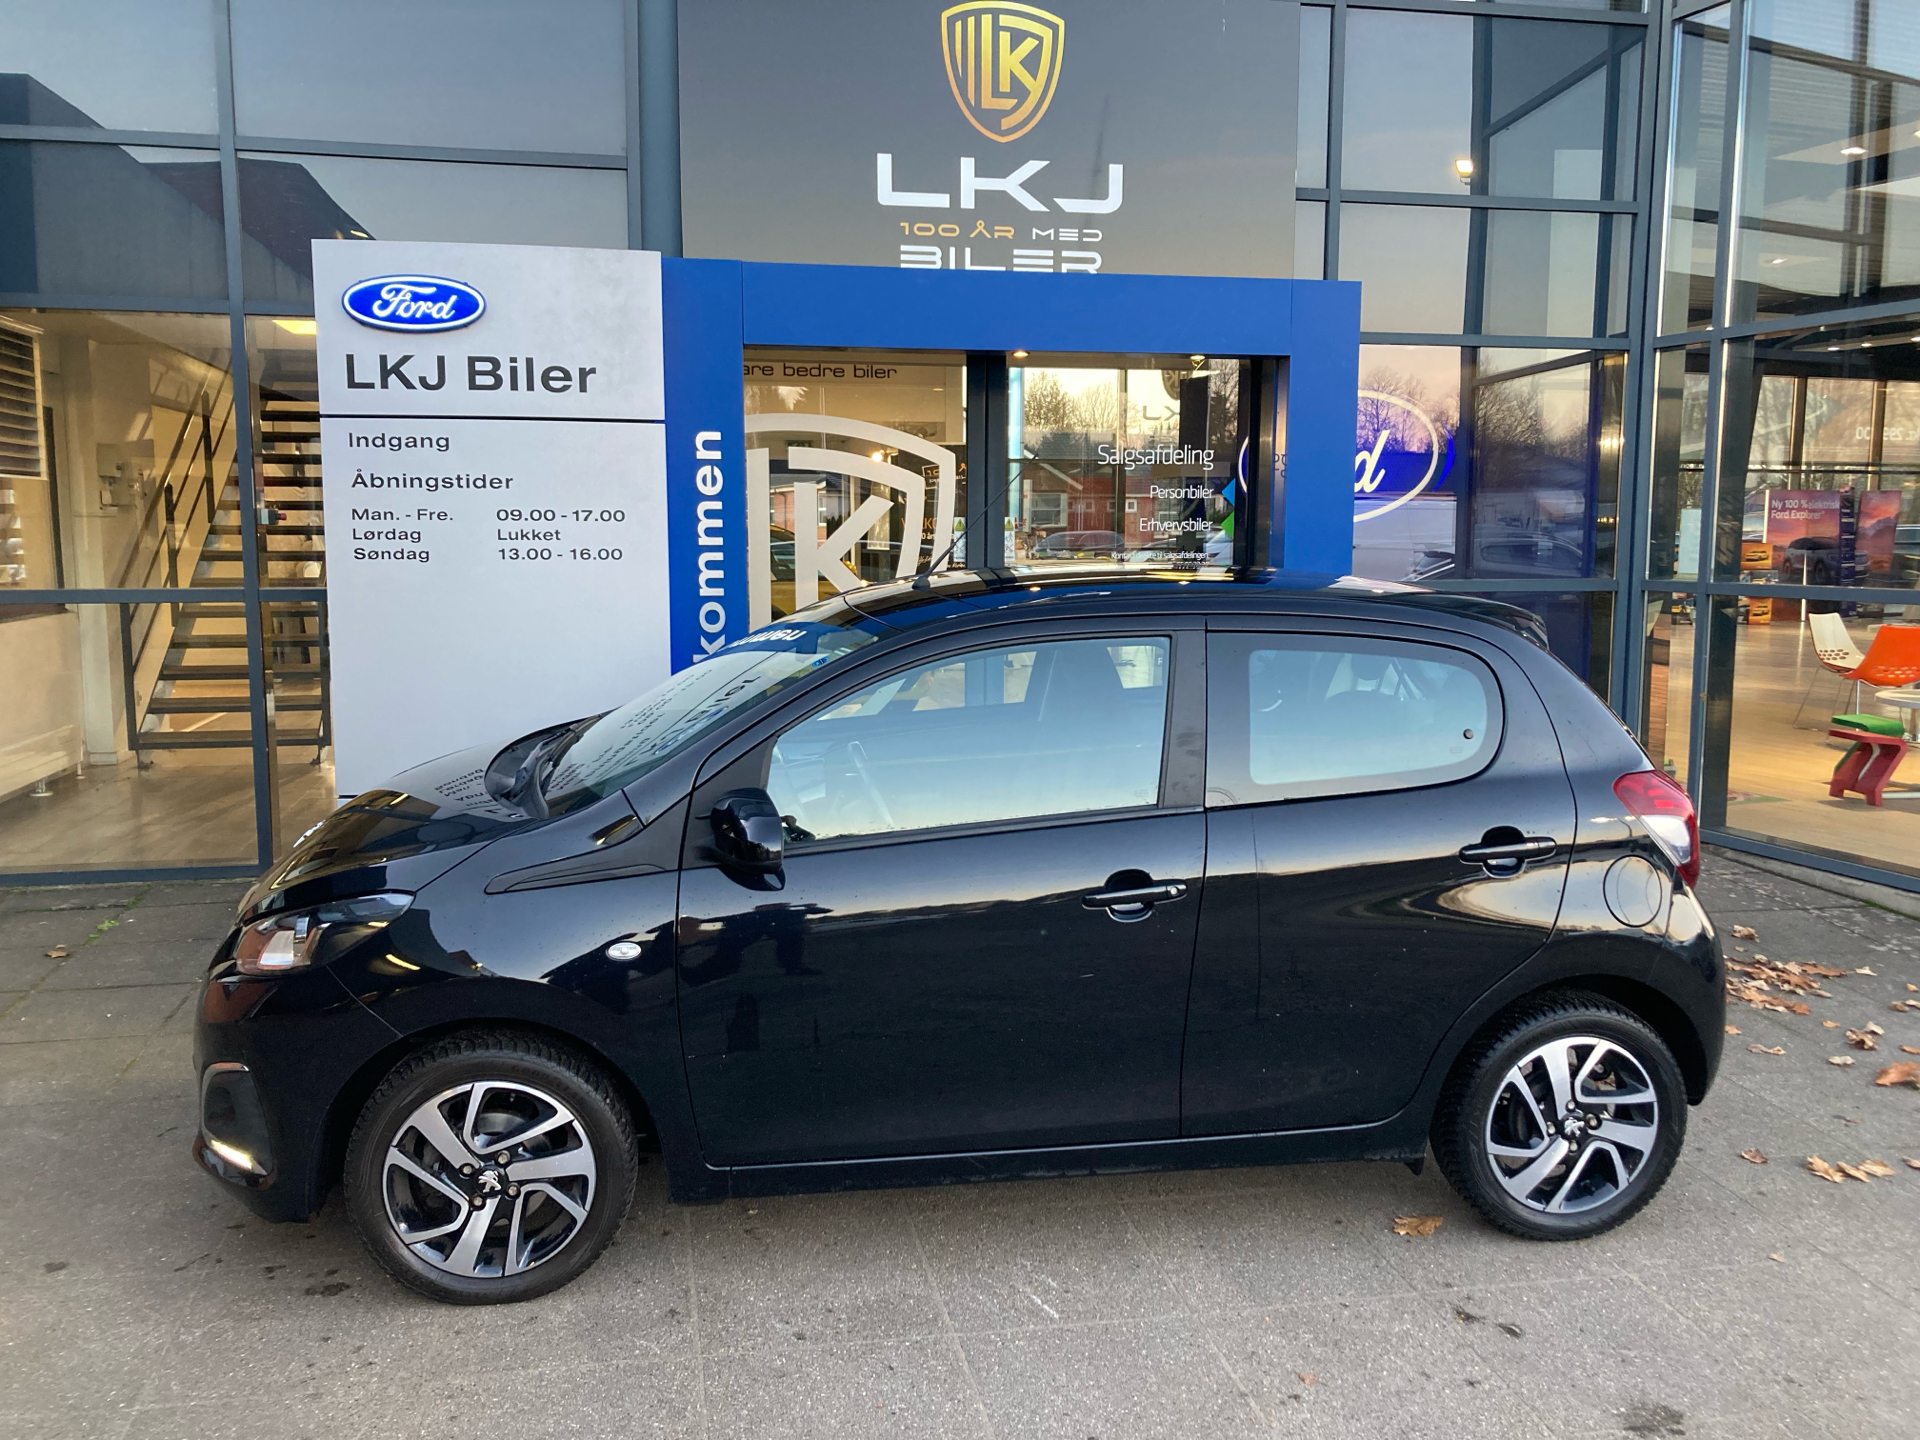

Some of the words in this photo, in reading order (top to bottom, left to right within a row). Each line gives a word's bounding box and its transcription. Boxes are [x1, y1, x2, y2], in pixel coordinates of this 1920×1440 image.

[876, 152, 1124, 215] LKJ
[899, 221, 960, 238] 100
[969, 219, 1016, 240] ÅR
[1031, 226, 1103, 243] MED
[899, 244, 1103, 275] BILER
[372, 283, 459, 321] Ford
[345, 353, 447, 392] LKJ
[466, 355, 597, 394] Biler
[783, 362, 846, 378] bedre
[853, 364, 898, 379] biler
[348, 432, 451, 452] Indgang
[1097, 443, 1215, 471] Salgsafdeling
[351, 468, 514, 493] Åbningstider
[1150, 484, 1215, 500] Personbiler
[1771, 499, 1784, 510] Ny
[1785, 499, 1799, 509] 100
[350, 507, 401, 522] Man.
[416, 508, 454, 522] Fre.
[495, 508, 557, 524] 09.00
[571, 508, 626, 524] 17.00
[1771, 509, 1789, 519] Ford
[1139, 517, 1214, 533] Erhvervsbiler
[352, 527, 422, 544] Lørdag
[496, 527, 562, 542] Lukket
[353, 547, 430, 563] Søndag
[498, 547, 553, 562] 13.00
[569, 547, 624, 562] 16.00
